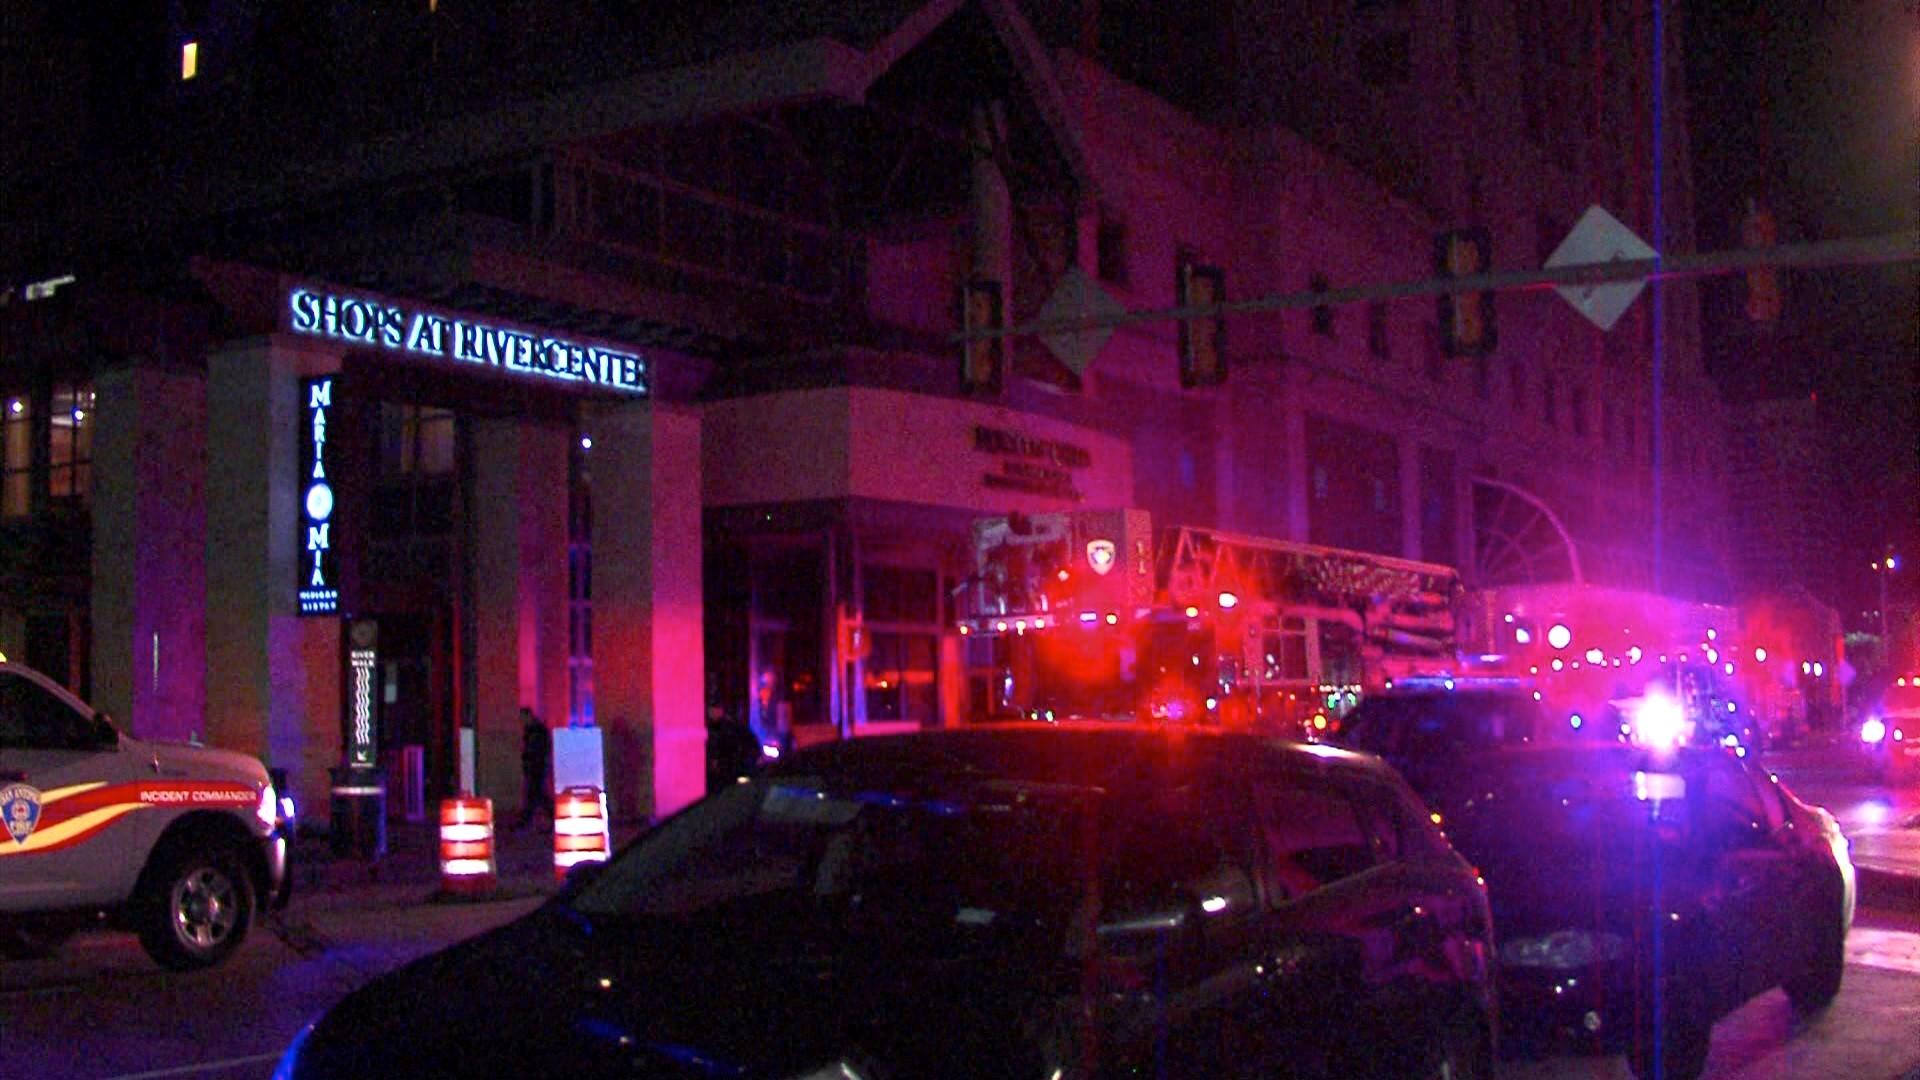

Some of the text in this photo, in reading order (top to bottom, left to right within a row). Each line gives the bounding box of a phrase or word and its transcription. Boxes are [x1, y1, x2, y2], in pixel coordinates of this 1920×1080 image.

[291, 289, 647, 393] SHOPS AT RIVERCENTER
[307, 380, 332, 586] MARIA MIA
[140, 790, 257, 802] INCIDENT COMMANDER
